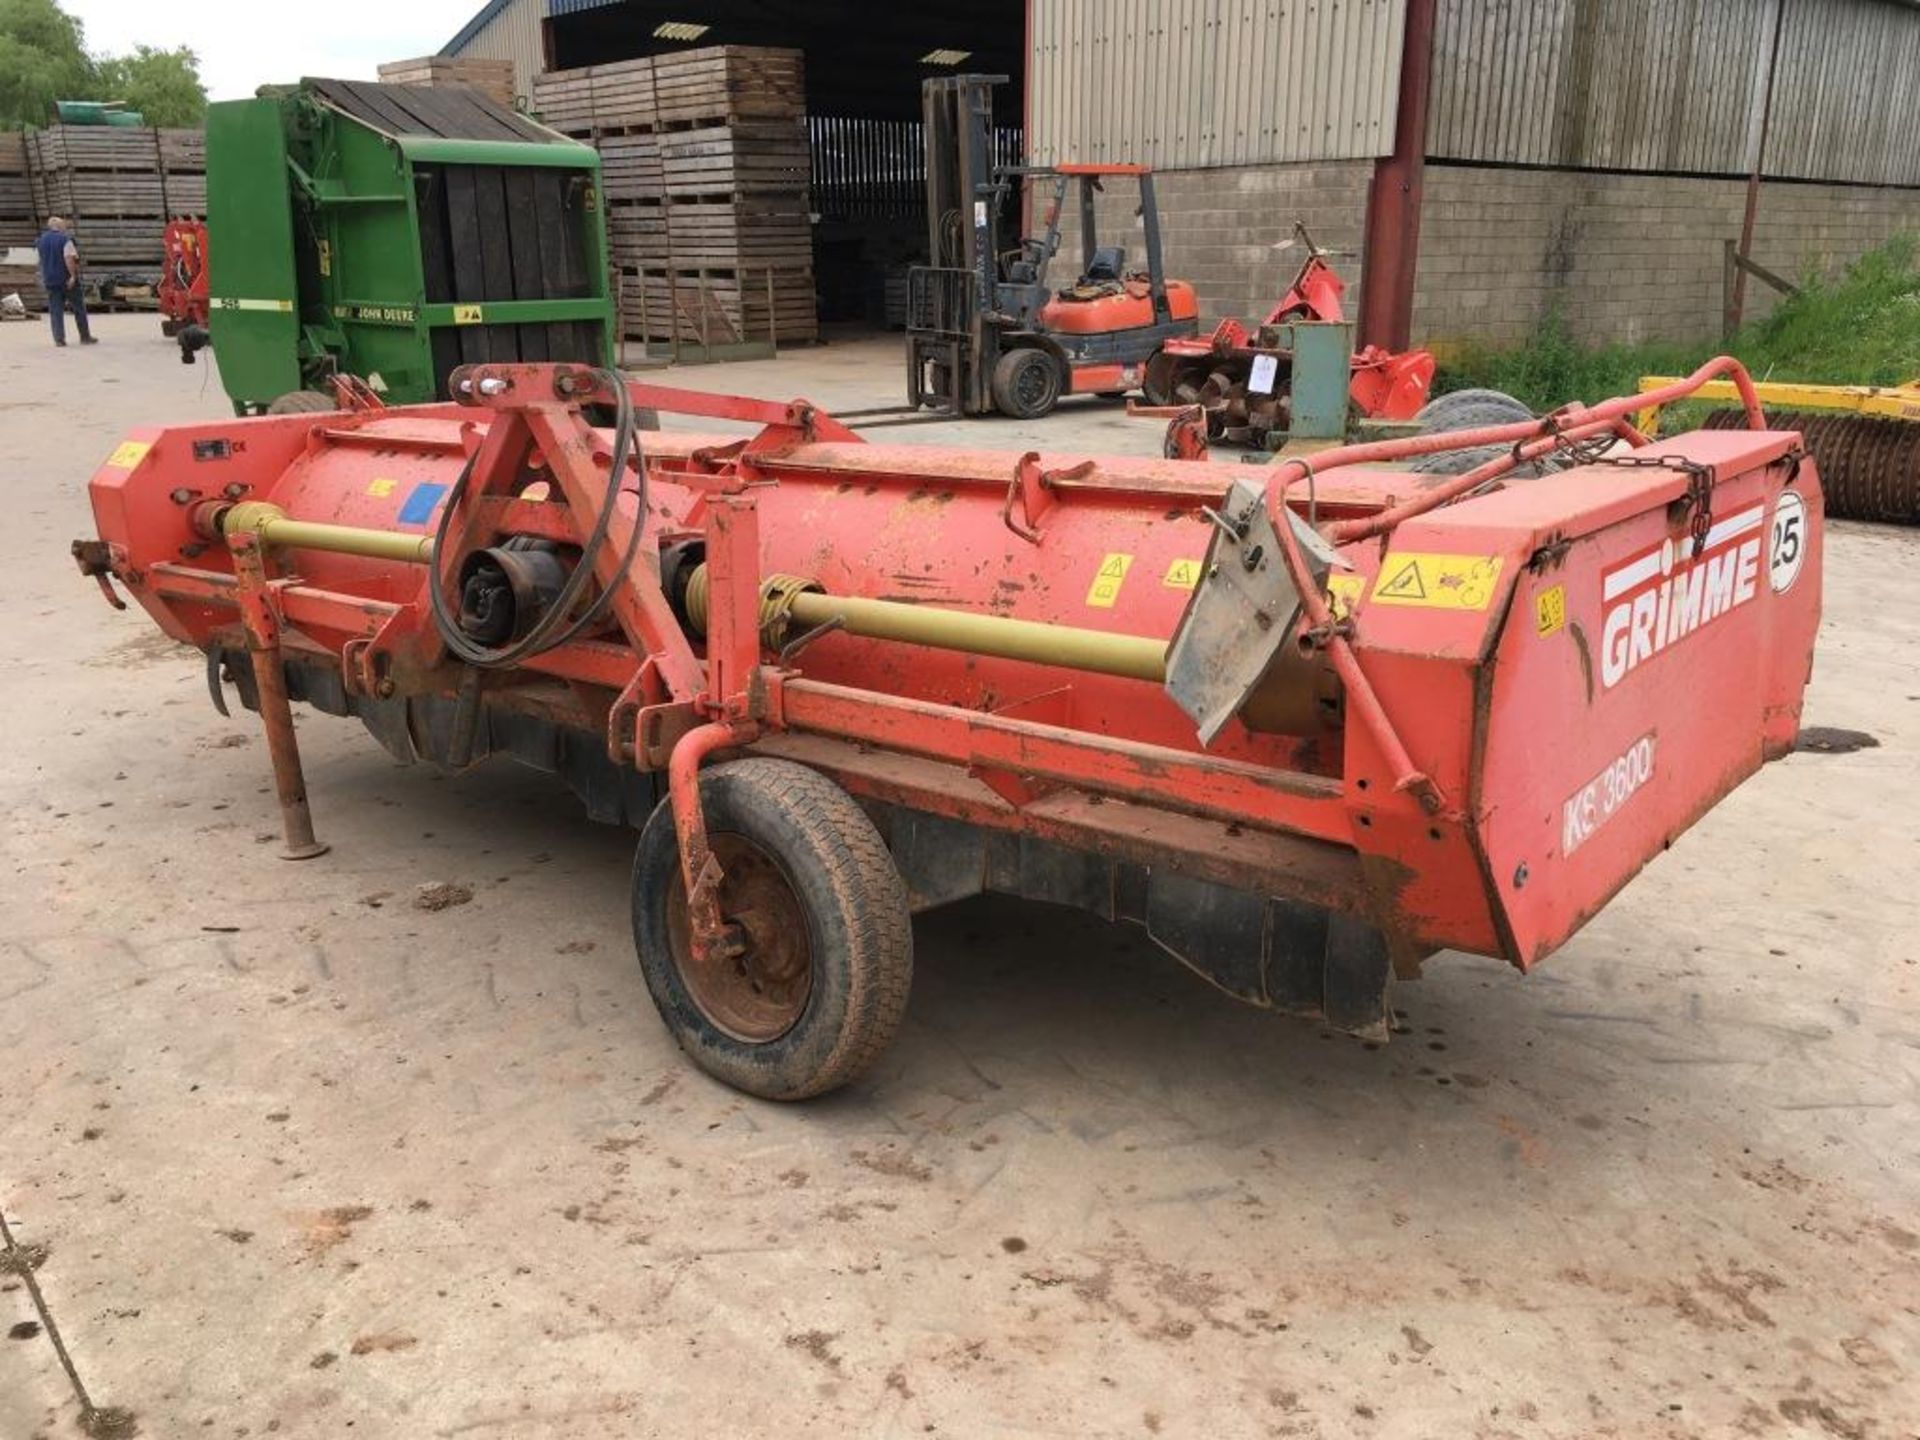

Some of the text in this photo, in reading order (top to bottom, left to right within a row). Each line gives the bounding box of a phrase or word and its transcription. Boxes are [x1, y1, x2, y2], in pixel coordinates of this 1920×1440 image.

[358, 307, 381, 319] JOHN
[383, 309, 414, 322] DEERE
[1771, 517, 1799, 569] 25
[1604, 738, 1650, 813] 3600
